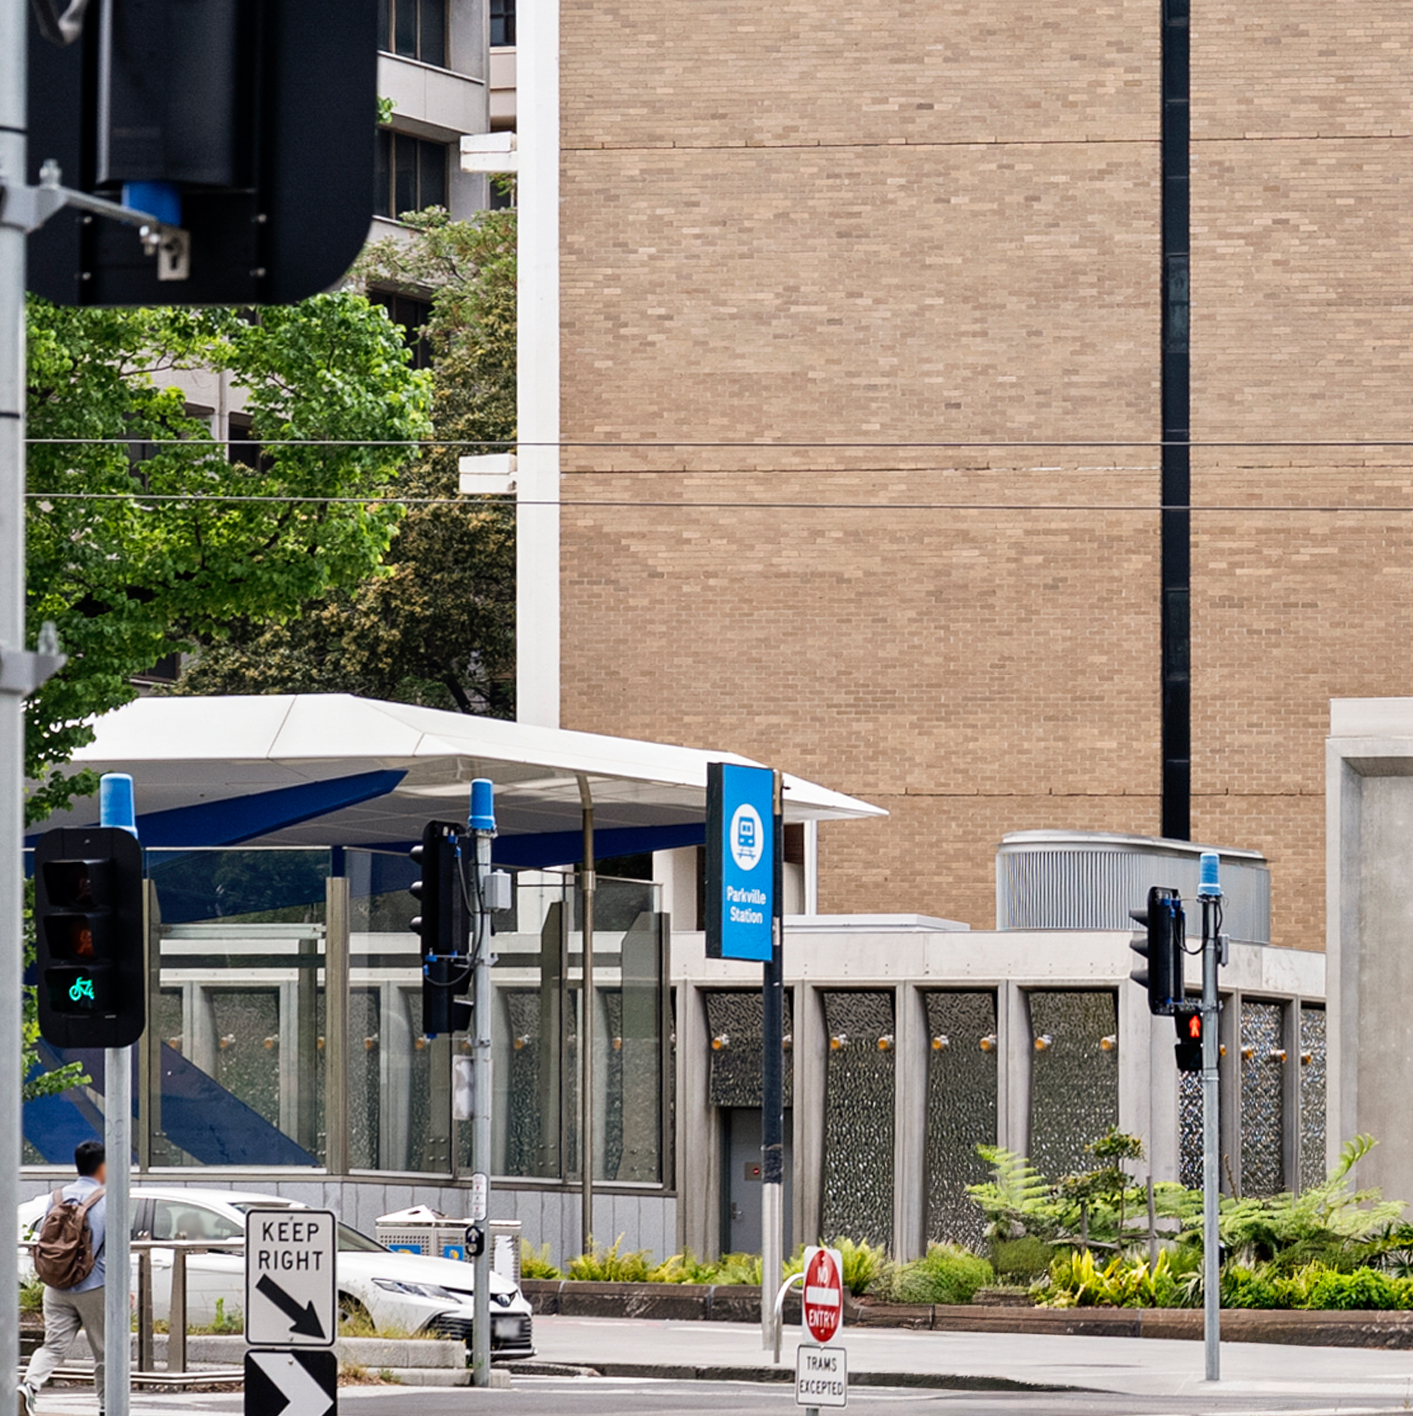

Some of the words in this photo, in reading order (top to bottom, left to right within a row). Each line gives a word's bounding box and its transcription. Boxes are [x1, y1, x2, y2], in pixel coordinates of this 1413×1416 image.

[726, 885, 767, 905] Parkville
[730, 905, 763, 924] Station
[262, 1221, 319, 1242] KEEP
[258, 1250, 323, 1271] RIGHT
[817, 1266, 828, 1283] NO
[808, 1308, 836, 1329] ENTRY
[807, 1355, 837, 1372] TRAMS
[799, 1379, 844, 1396] EXCEPTED
